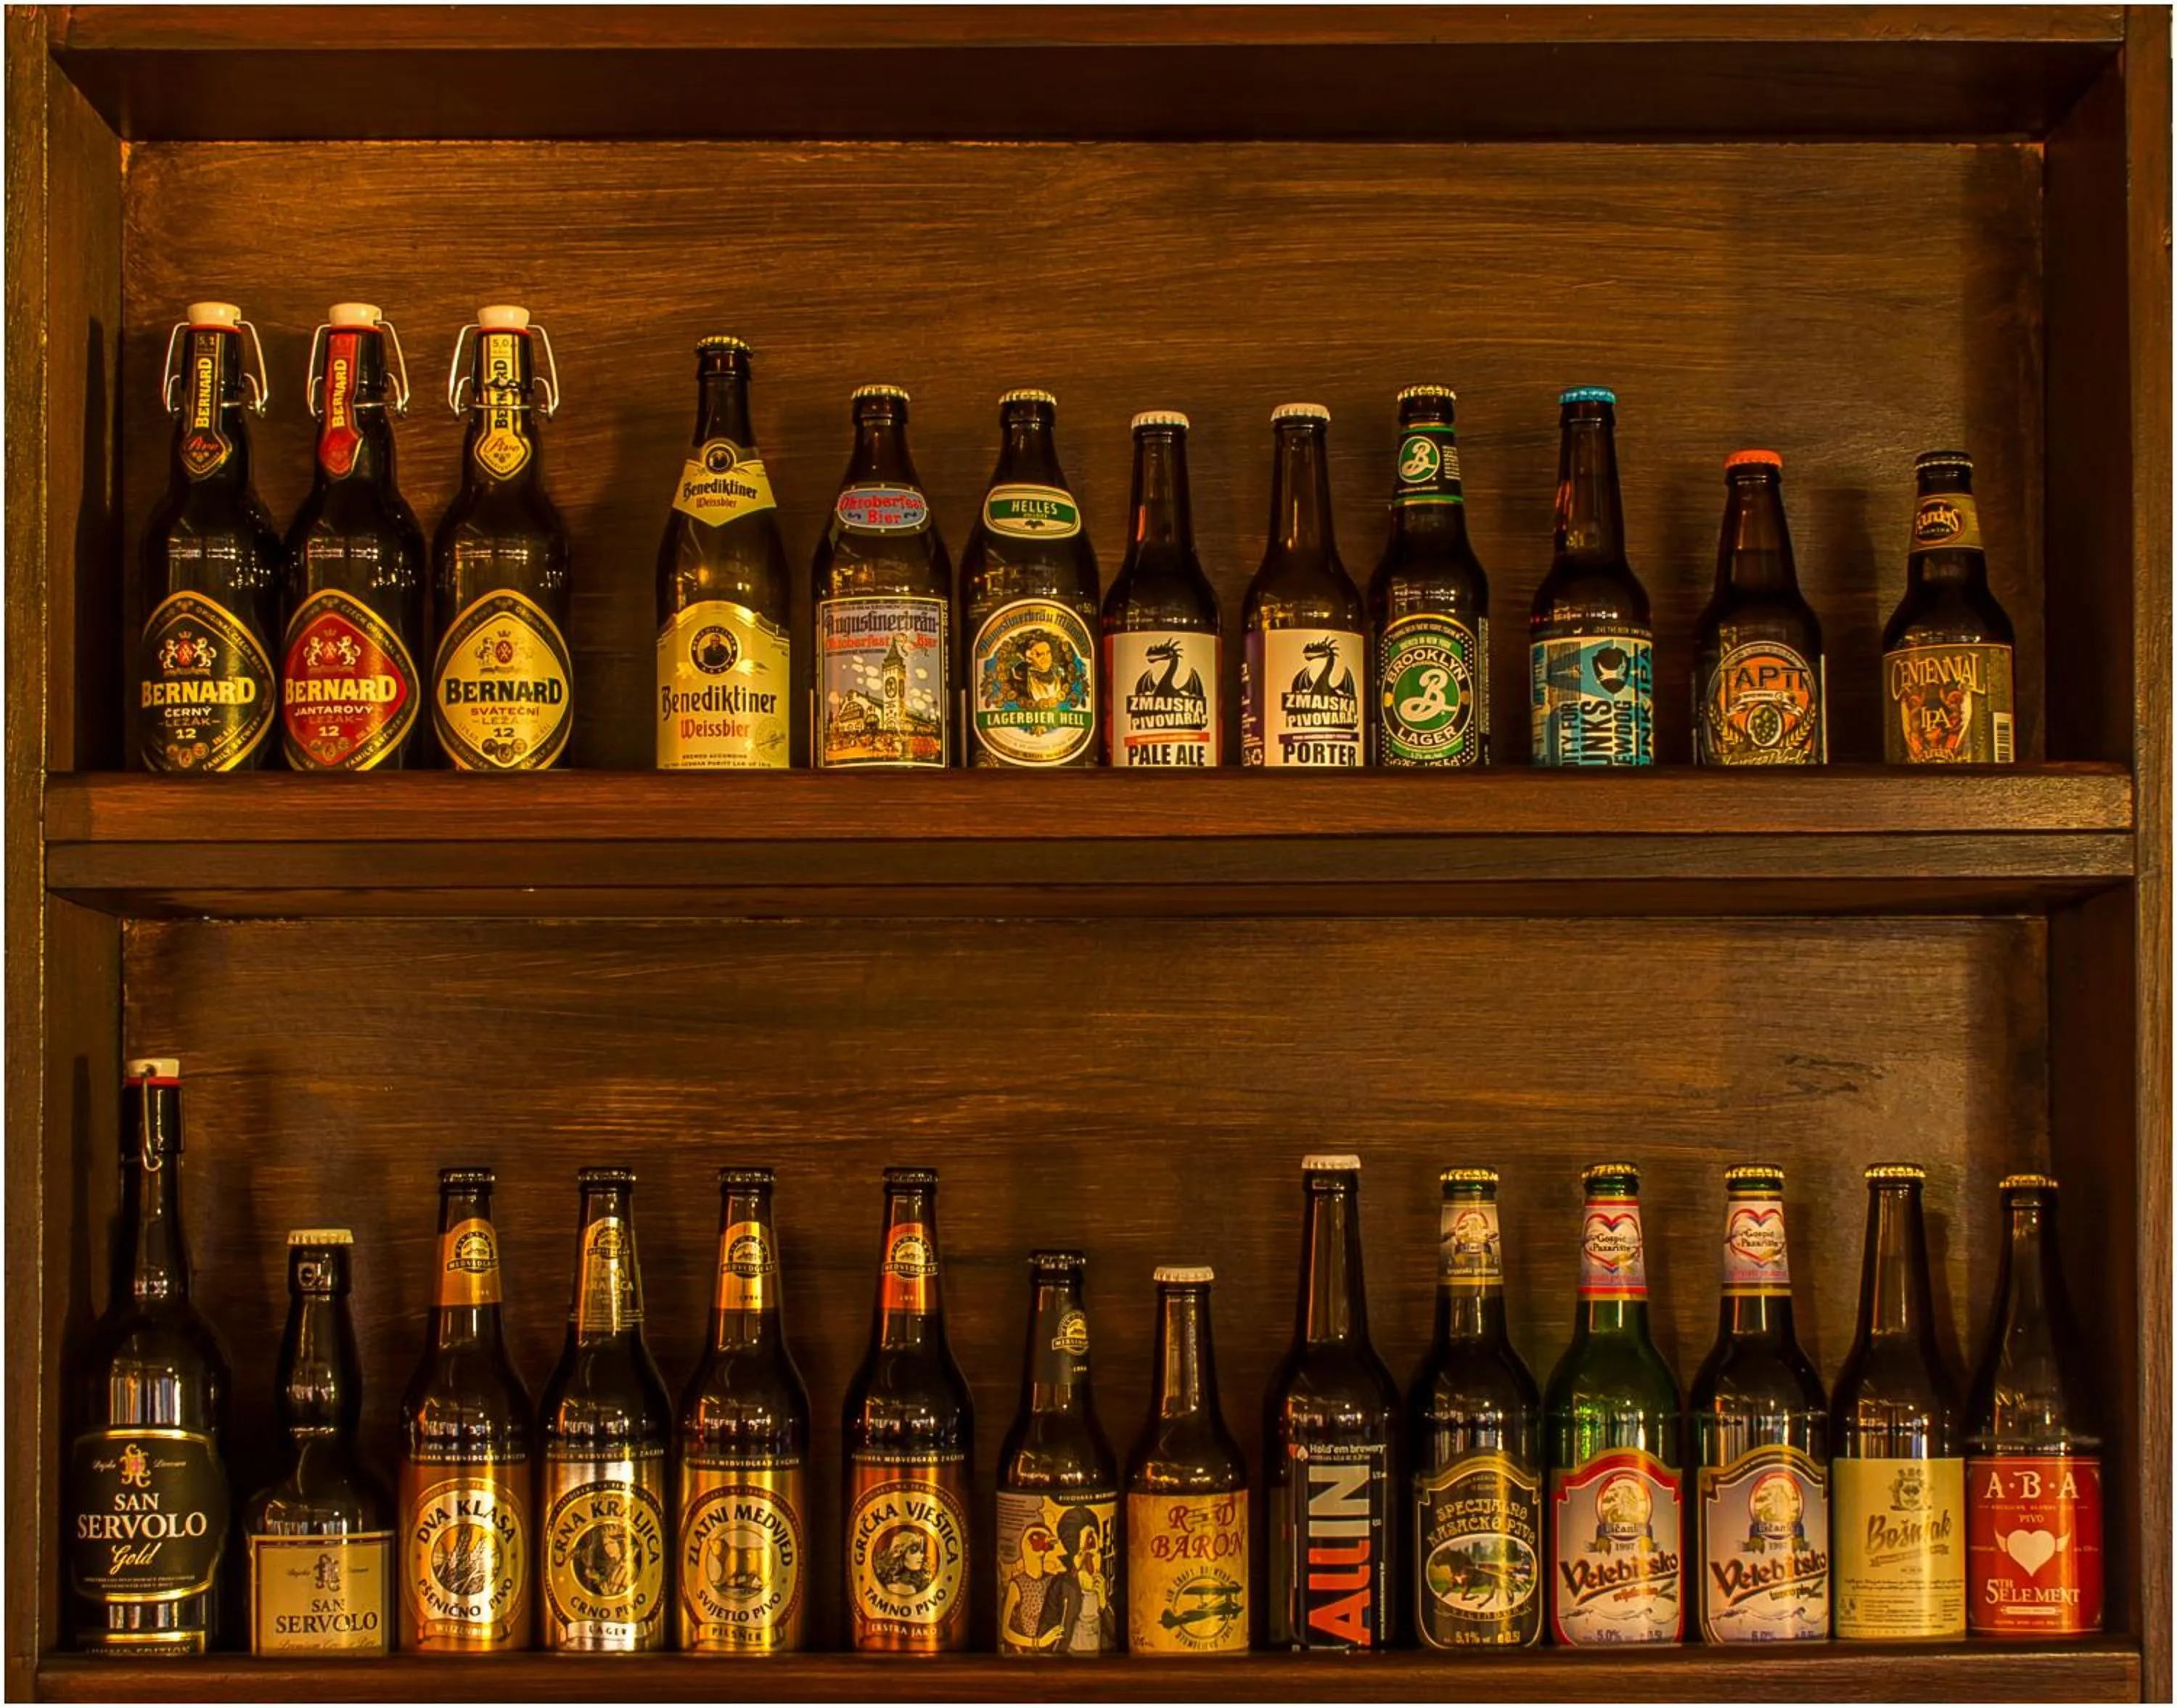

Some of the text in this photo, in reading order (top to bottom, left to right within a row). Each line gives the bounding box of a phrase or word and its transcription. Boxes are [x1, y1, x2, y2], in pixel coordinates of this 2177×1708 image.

[195, 358, 213, 428] BERNARD
[332, 359, 347, 428] BERNARD
[494, 360, 508, 428] BENRD
[683, 479, 758, 502] Benediktiner
[867, 509, 901, 524] Bier
[1011, 500, 1057, 514] HELLES
[1387, 649, 1467, 684] BROOKLYN
[142, 676, 255, 708] BERNARD
[285, 675, 398, 705] BERNARD
[445, 677, 563, 705] BERNARD
[165, 706, 212, 718] ČERNÝ
[661, 685, 776, 721] Benediktiner
[1130, 697, 1204, 713] ZMAJSKA
[1285, 694, 1356, 713] ZMAJSKA
[1561, 702, 1579, 729] FOR
[319, 726, 340, 737] 12
[681, 718, 750, 739] Weissbier
[986, 712, 1084, 726] LAGERBIER HELL
[1922, 707, 1951, 732] IPA
[175, 728, 197, 739] 12
[493, 727, 516, 738] 12
[1398, 726, 1457, 745] LAGER
[1128, 744, 1205, 767] PALE ALE
[1283, 742, 1356, 767] PORTER
[114, 1493, 160, 1511] SAN
[78, 1511, 208, 1539] SERVOLO
[417, 1499, 517, 1544] DVA KLASA
[2019, 1514, 2045, 1523] PIVO
[553, 1499, 660, 1568] CRNA KRALJICA
[689, 1503, 793, 1568] ZLATNI MEDVJED
[853, 1502, 899, 1567] GRIČKA
[905, 1500, 959, 1565] VJEŠTICA
[1151, 1527, 1245, 1562] BARON
[110, 1542, 163, 1575] Gold
[311, 1598, 345, 1614] SAN
[417, 1577, 514, 1619] PŠENIČNO PIVO
[570, 1593, 647, 1619] CRNO PIVO
[697, 1589, 782, 1623] SVIJETLO PIVO
[864, 1586, 947, 1617] TAMNO PIVO
[1998, 1587, 2080, 1606] ELEMENT
[275, 1612, 379, 1634] SERVOLO
[589, 1624, 628, 1636] LAGER
[711, 1627, 763, 1642] PILSNER
[871, 1624, 938, 1638] EKSTRA JAKO
